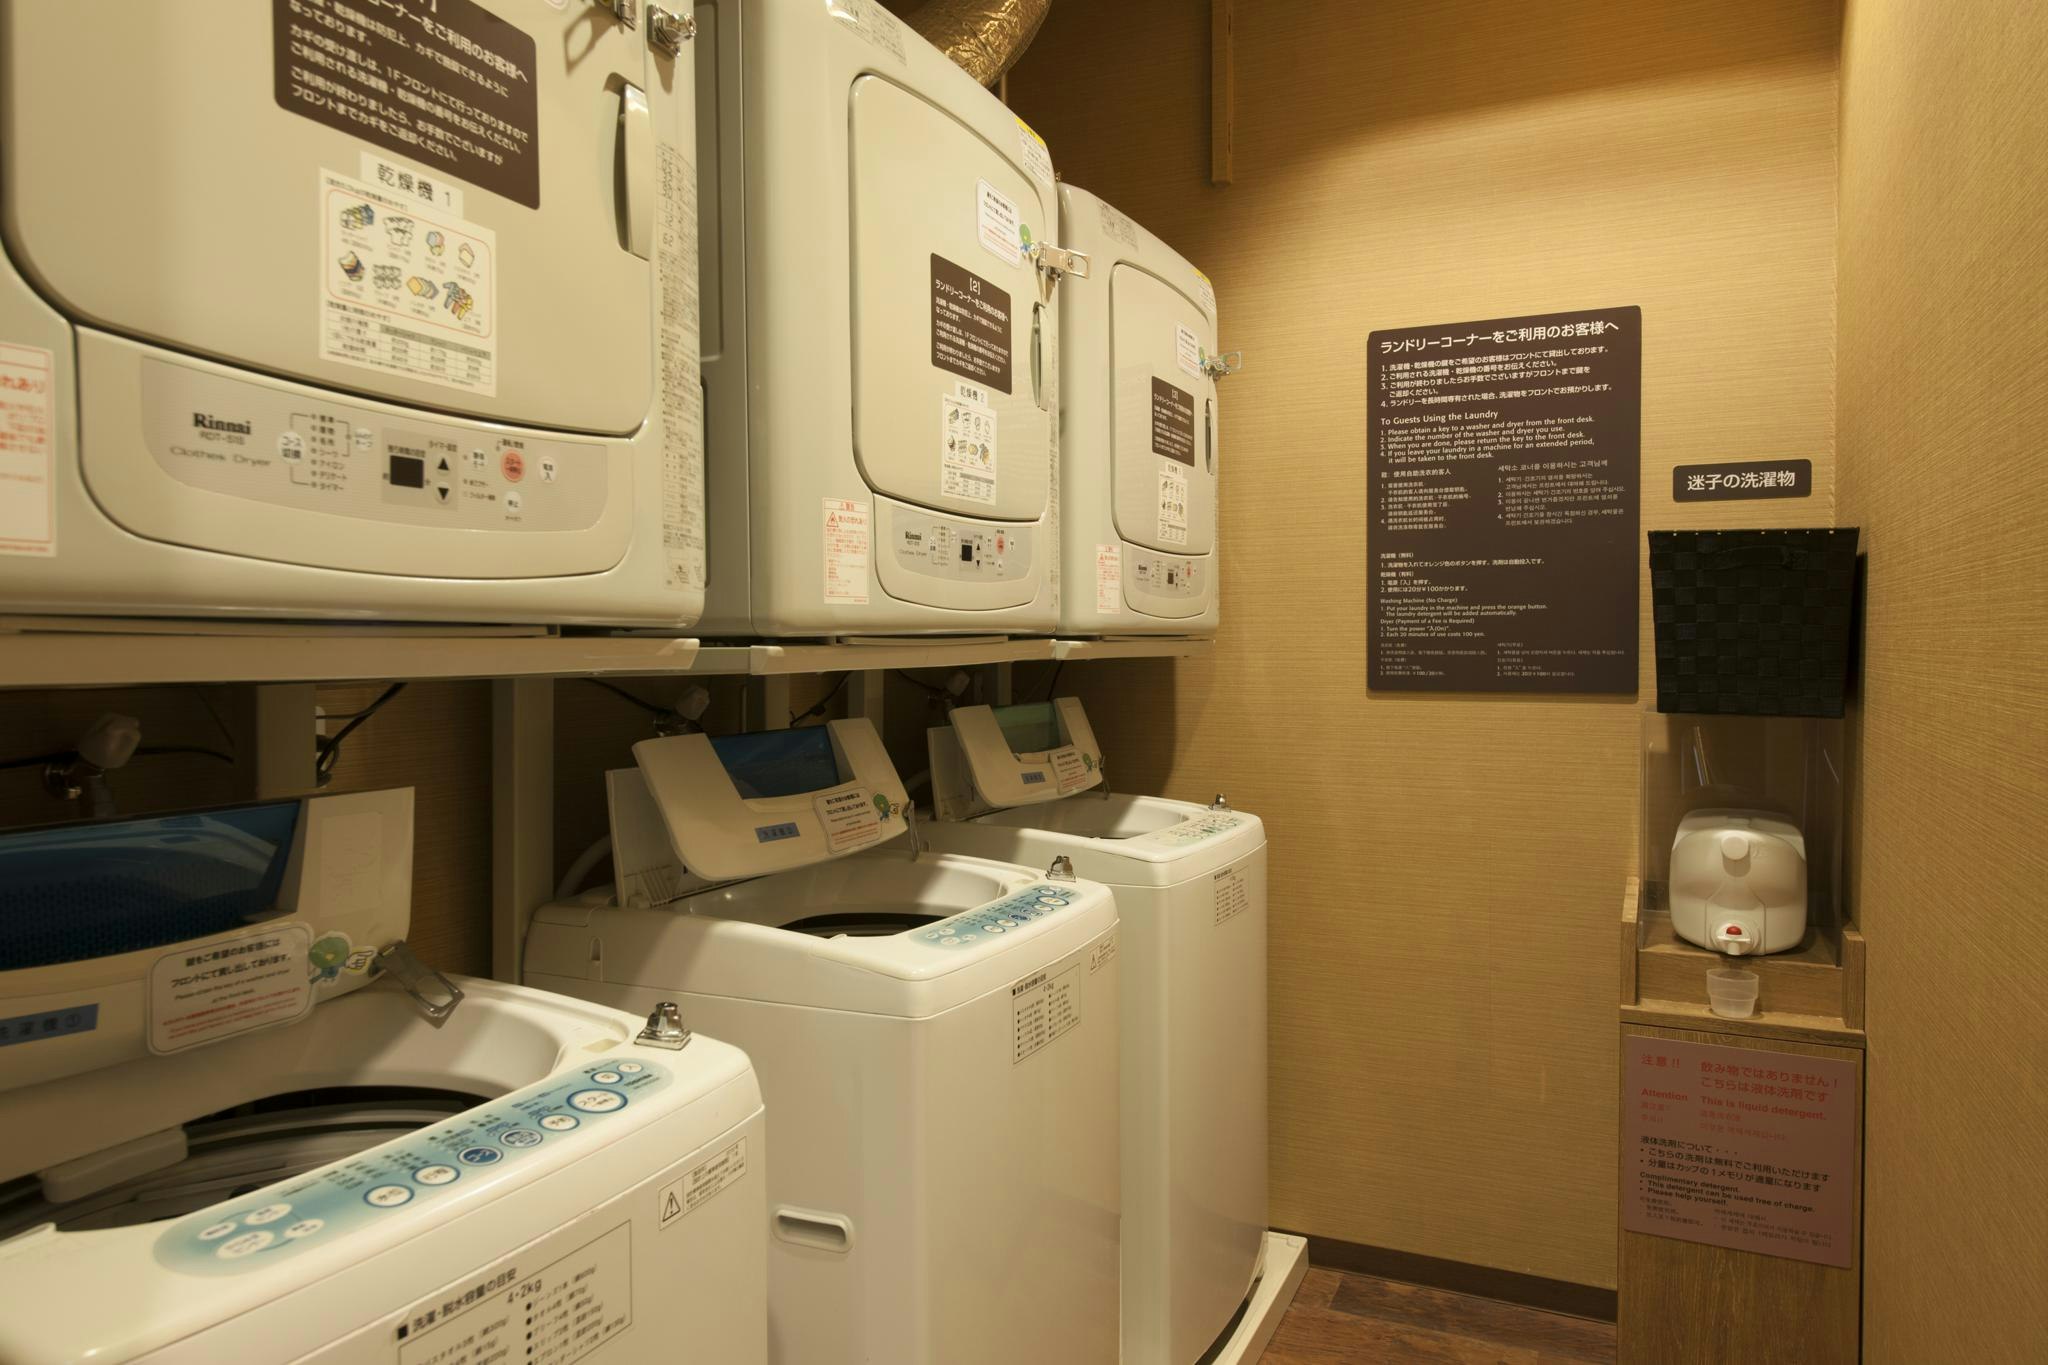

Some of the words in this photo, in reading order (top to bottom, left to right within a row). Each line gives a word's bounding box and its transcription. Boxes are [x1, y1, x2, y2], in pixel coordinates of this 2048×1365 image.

[1380, 320, 1619, 354] ランドリーコーナーをご利用のお客様へ
[193, 412, 251, 435] Rinnai
[1394, 417, 1420, 425] Guests
[1423, 414, 1446, 424] Using
[1464, 410, 1498, 420] Laundry
[170, 446, 226, 461] Clothes
[232, 453, 272, 467] Dryer
[1687, 470, 1796, 491] 迷子の洗濯物
[904, 530, 922, 541] Rinnai
[1701, 1077, 1831, 1103] こちらは液体洗剤です
[1640, 1088, 1688, 1101] Attention
[1701, 1096, 1723, 1107] This
[1739, 1100, 1768, 1114] liquid
[1771, 1104, 1826, 1120] detergent.
